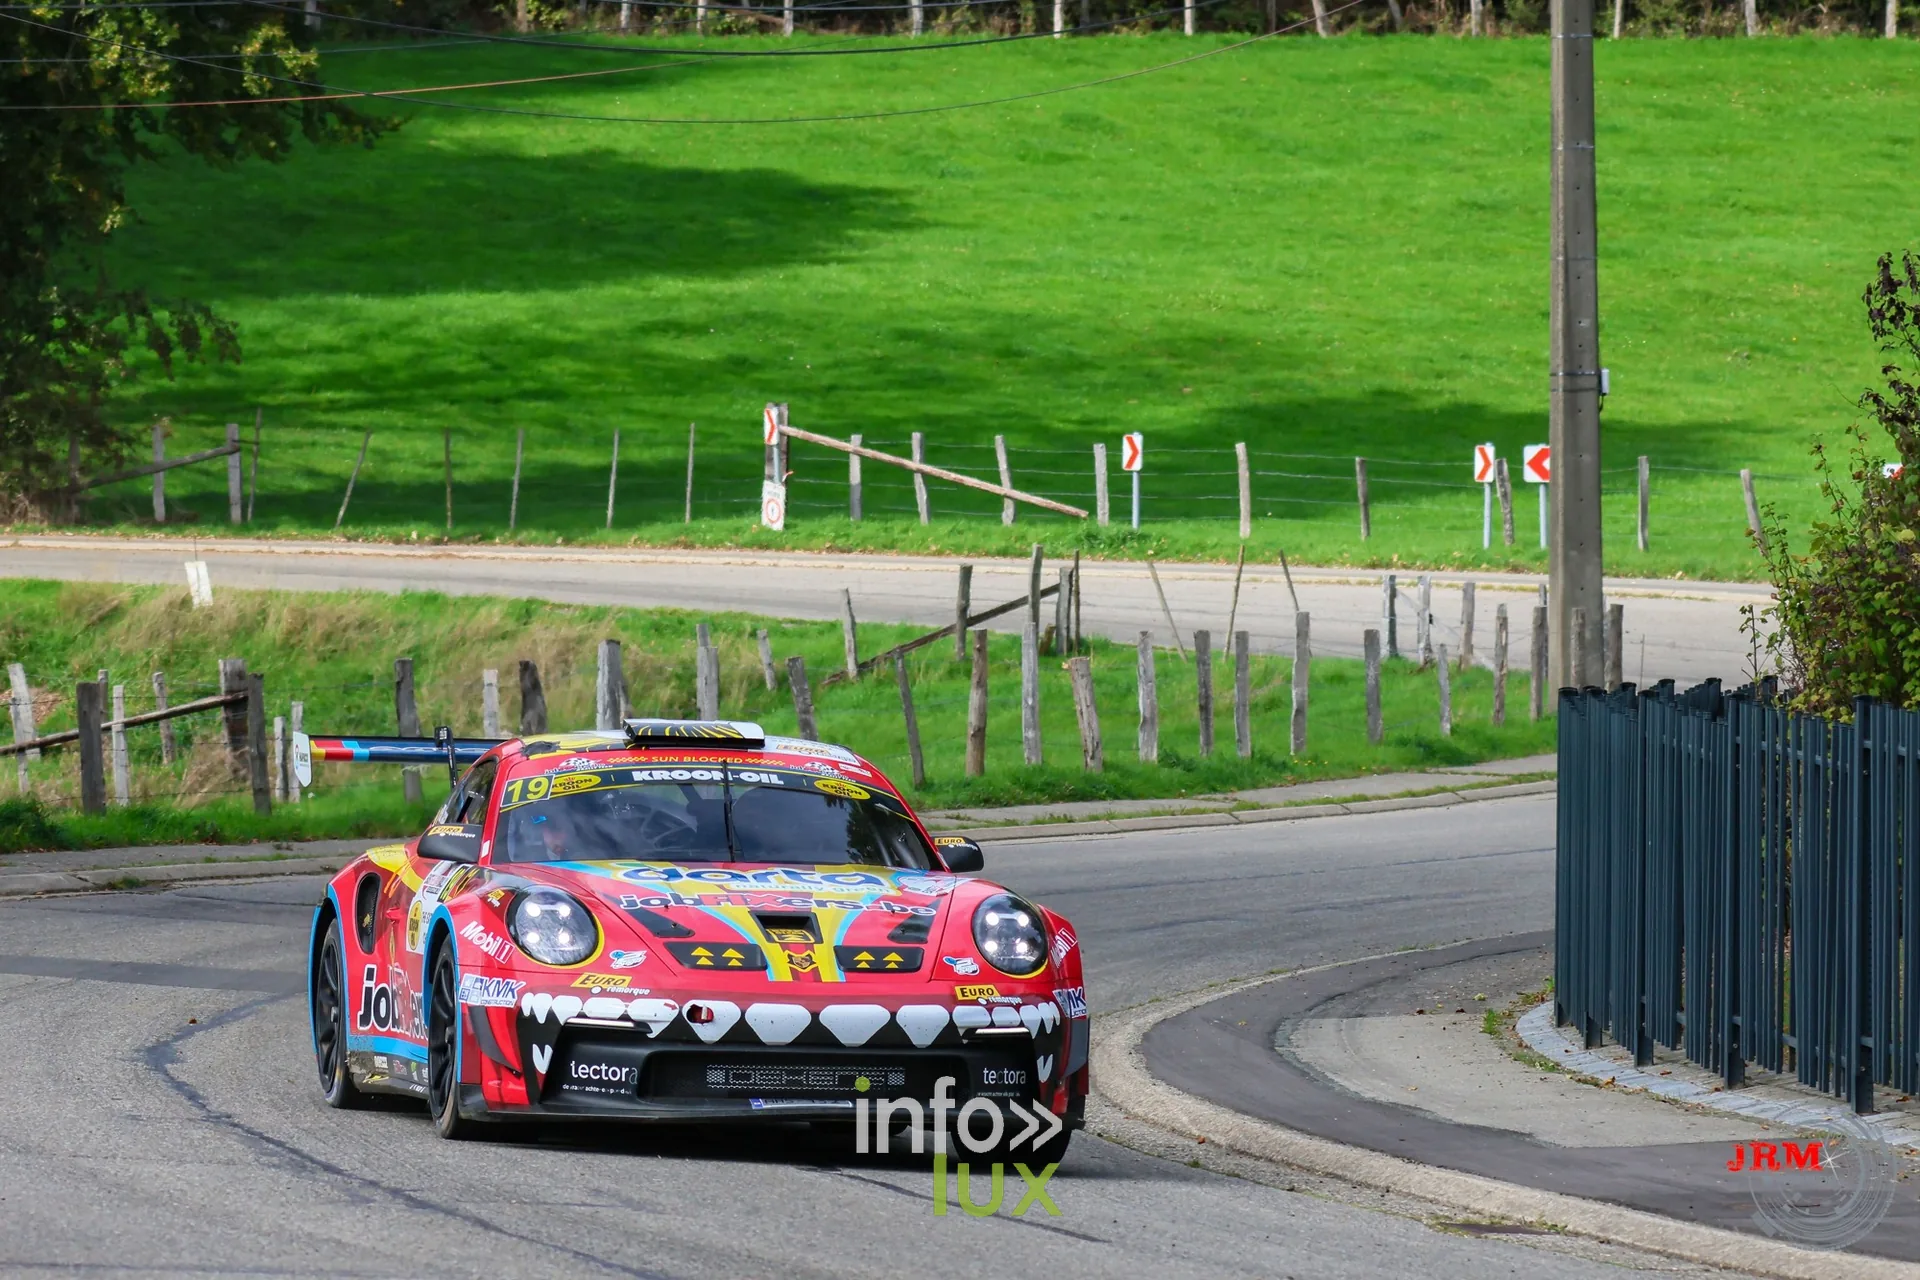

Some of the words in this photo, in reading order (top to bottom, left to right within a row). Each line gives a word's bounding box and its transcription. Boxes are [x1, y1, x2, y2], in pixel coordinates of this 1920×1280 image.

[683, 756, 743, 764] BLOCKED
[552, 778, 593, 788] KROON
[631, 769, 785, 785] KROON-OIL
[507, 777, 549, 803] 19
[460, 920, 503, 957] Mobil
[579, 974, 627, 986] EURO
[481, 979, 525, 1000] KMK
[960, 987, 995, 998] EURO
[570, 1060, 638, 1085] tectora
[983, 1067, 1026, 1085] tectora
